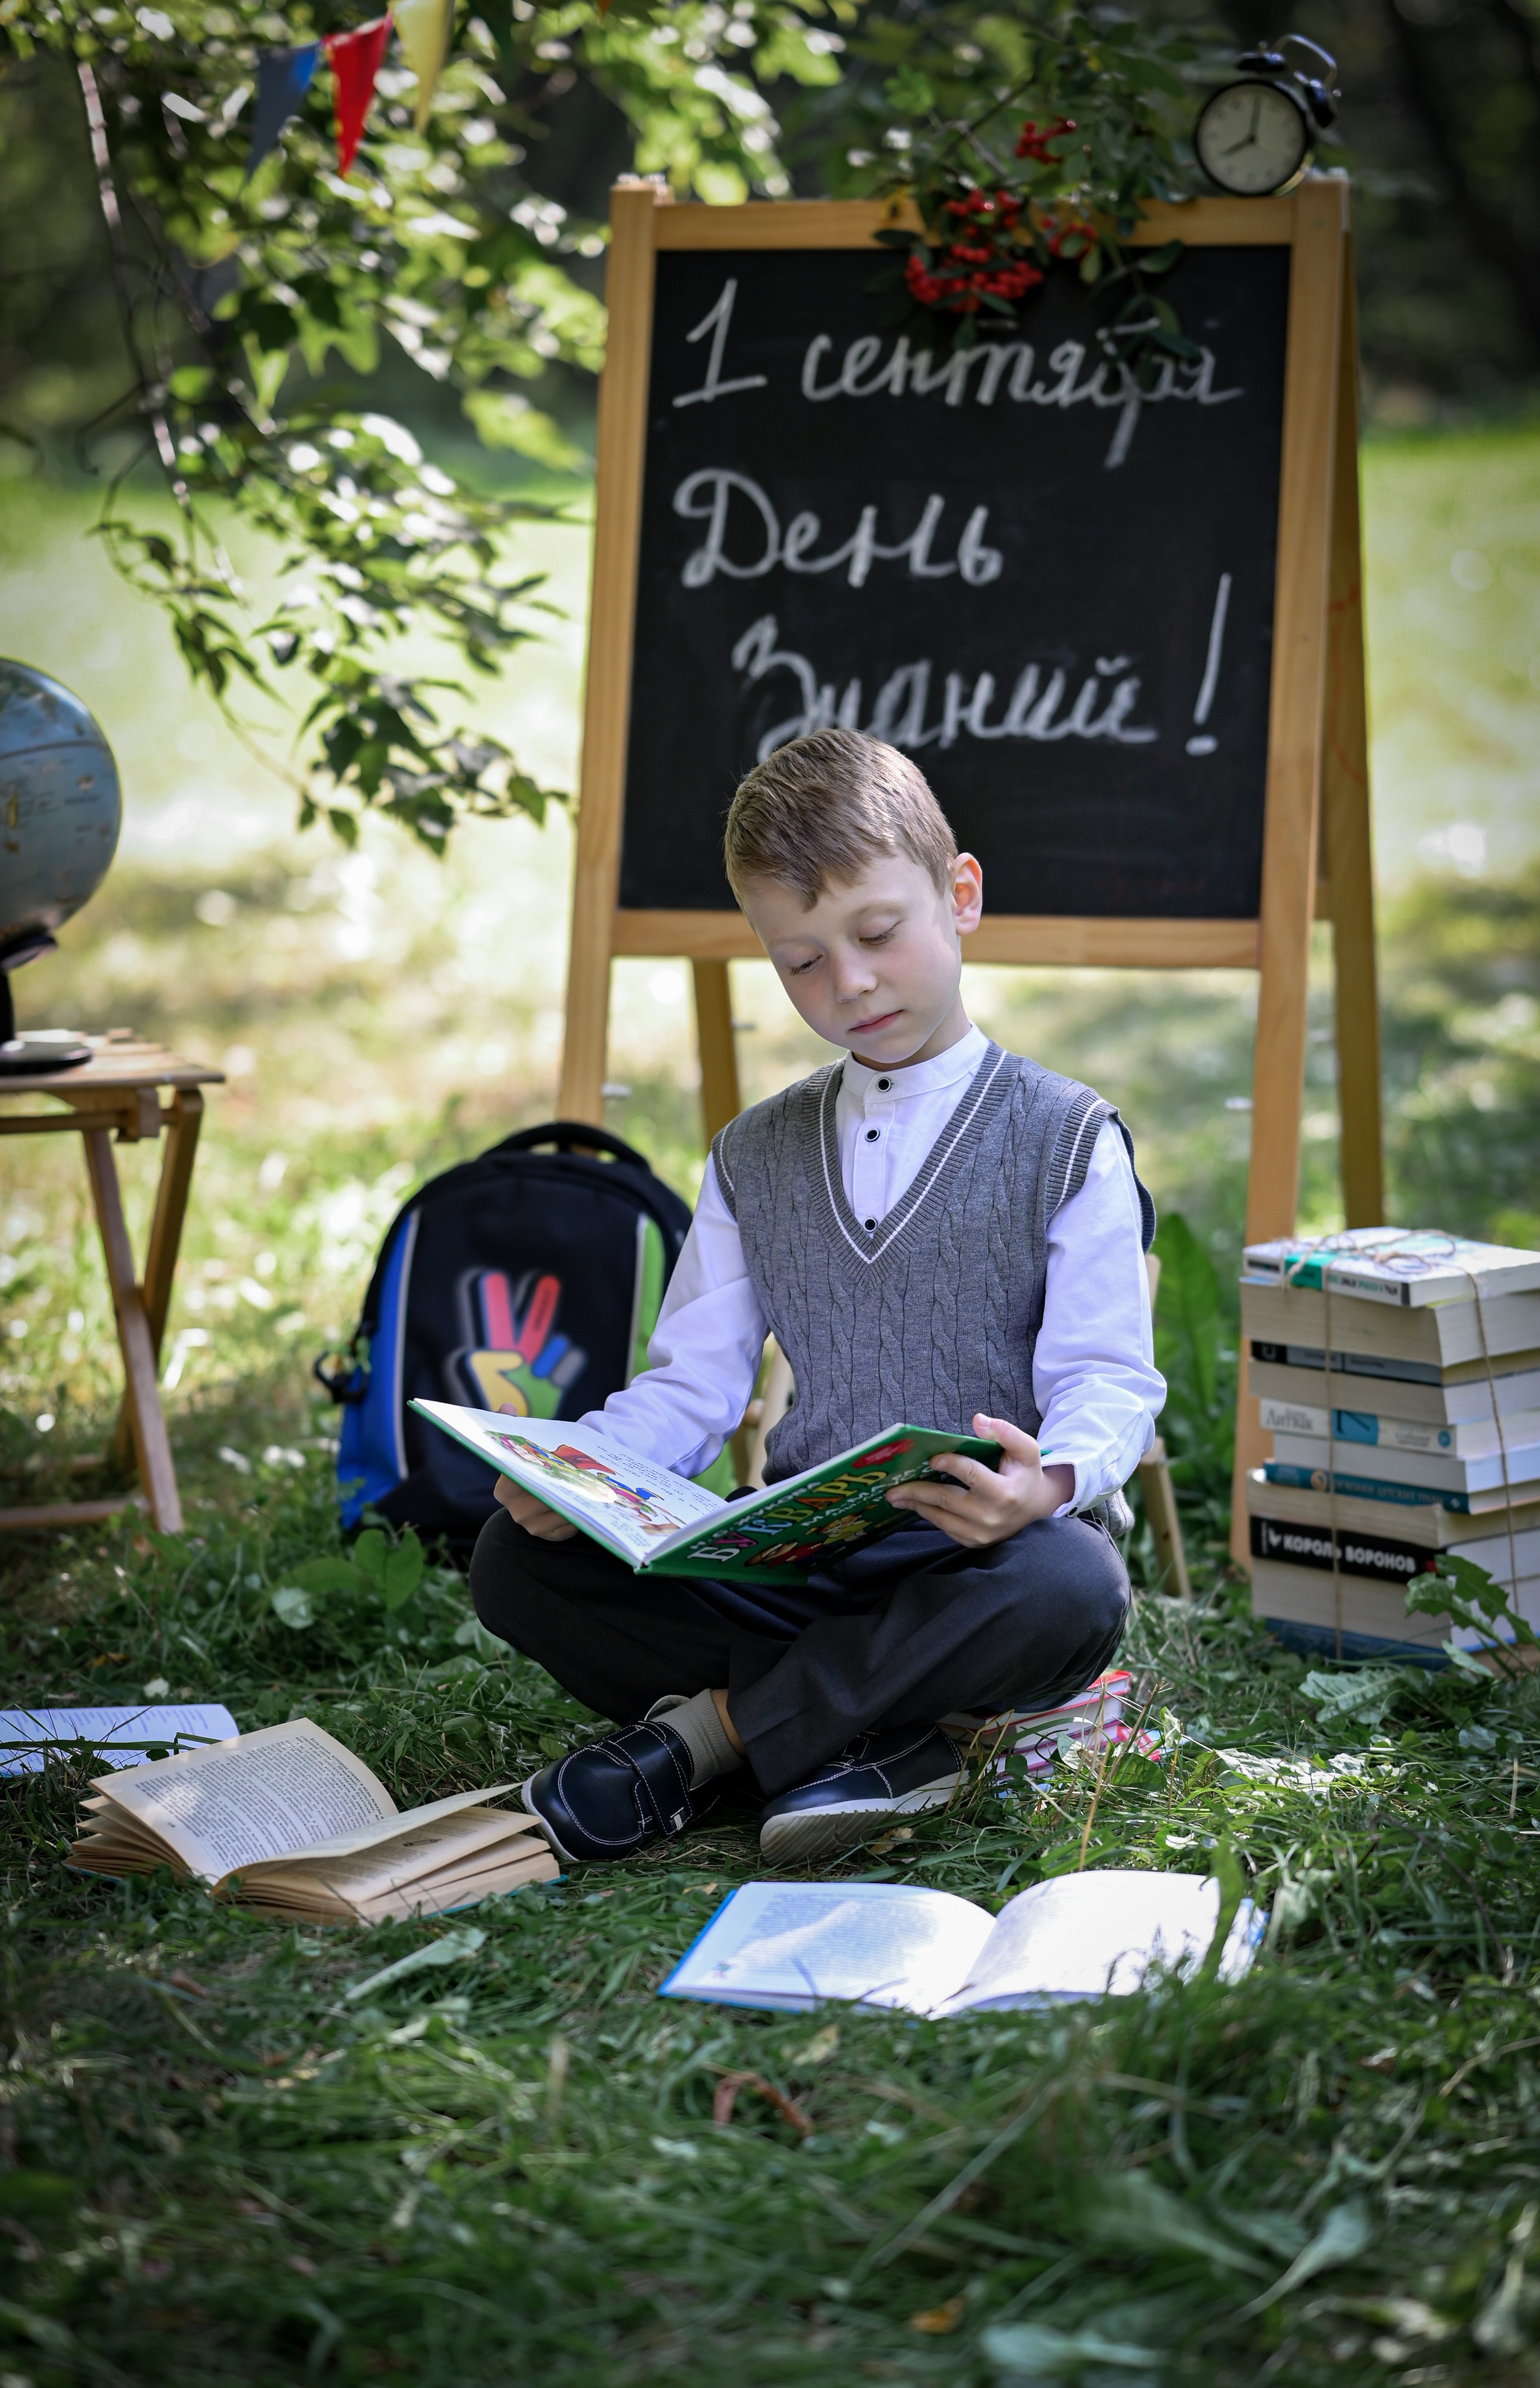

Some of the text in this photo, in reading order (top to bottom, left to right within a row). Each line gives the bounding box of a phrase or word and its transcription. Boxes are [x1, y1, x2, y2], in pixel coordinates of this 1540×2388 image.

[673, 278, 1245, 470] 1 сентября
[673, 468, 1003, 587] День
[686, 1470, 888, 1563] БУКВАРЬ
[1283, 1534, 1341, 1559] КОРОЛЬ
[1344, 1545, 1416, 1573] ВОРОНОВ
